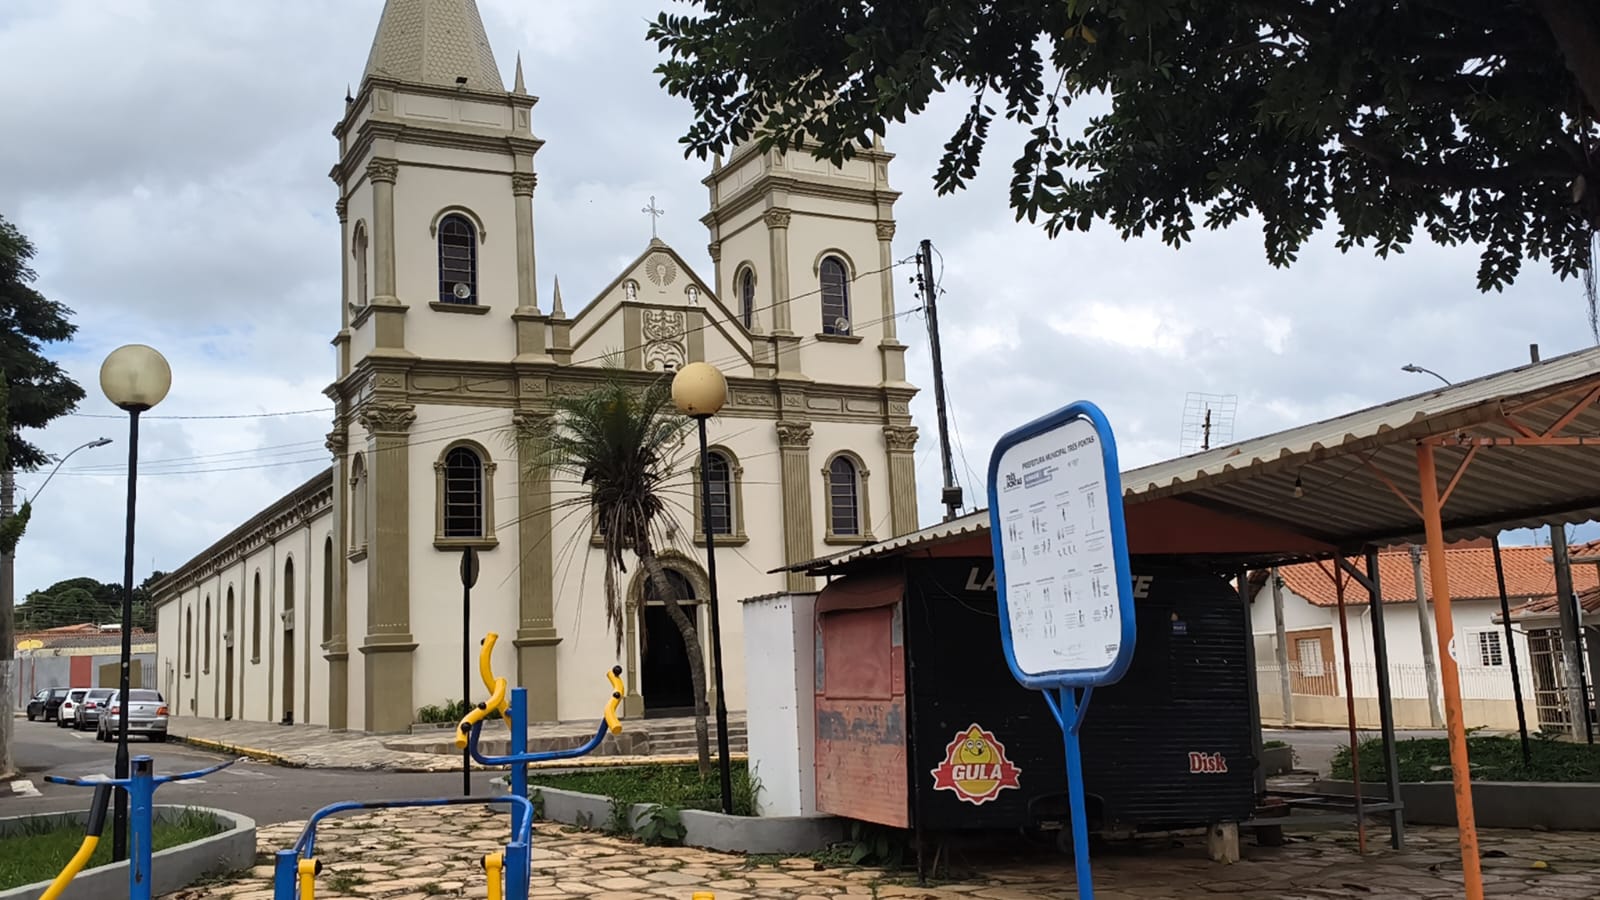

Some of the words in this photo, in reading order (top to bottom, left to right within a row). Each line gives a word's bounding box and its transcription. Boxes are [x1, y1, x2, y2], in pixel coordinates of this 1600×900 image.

[1045, 448, 1067, 461] MUNICIPAL
[1188, 751, 1229, 774] Disk
[952, 764, 1003, 781] GULA
